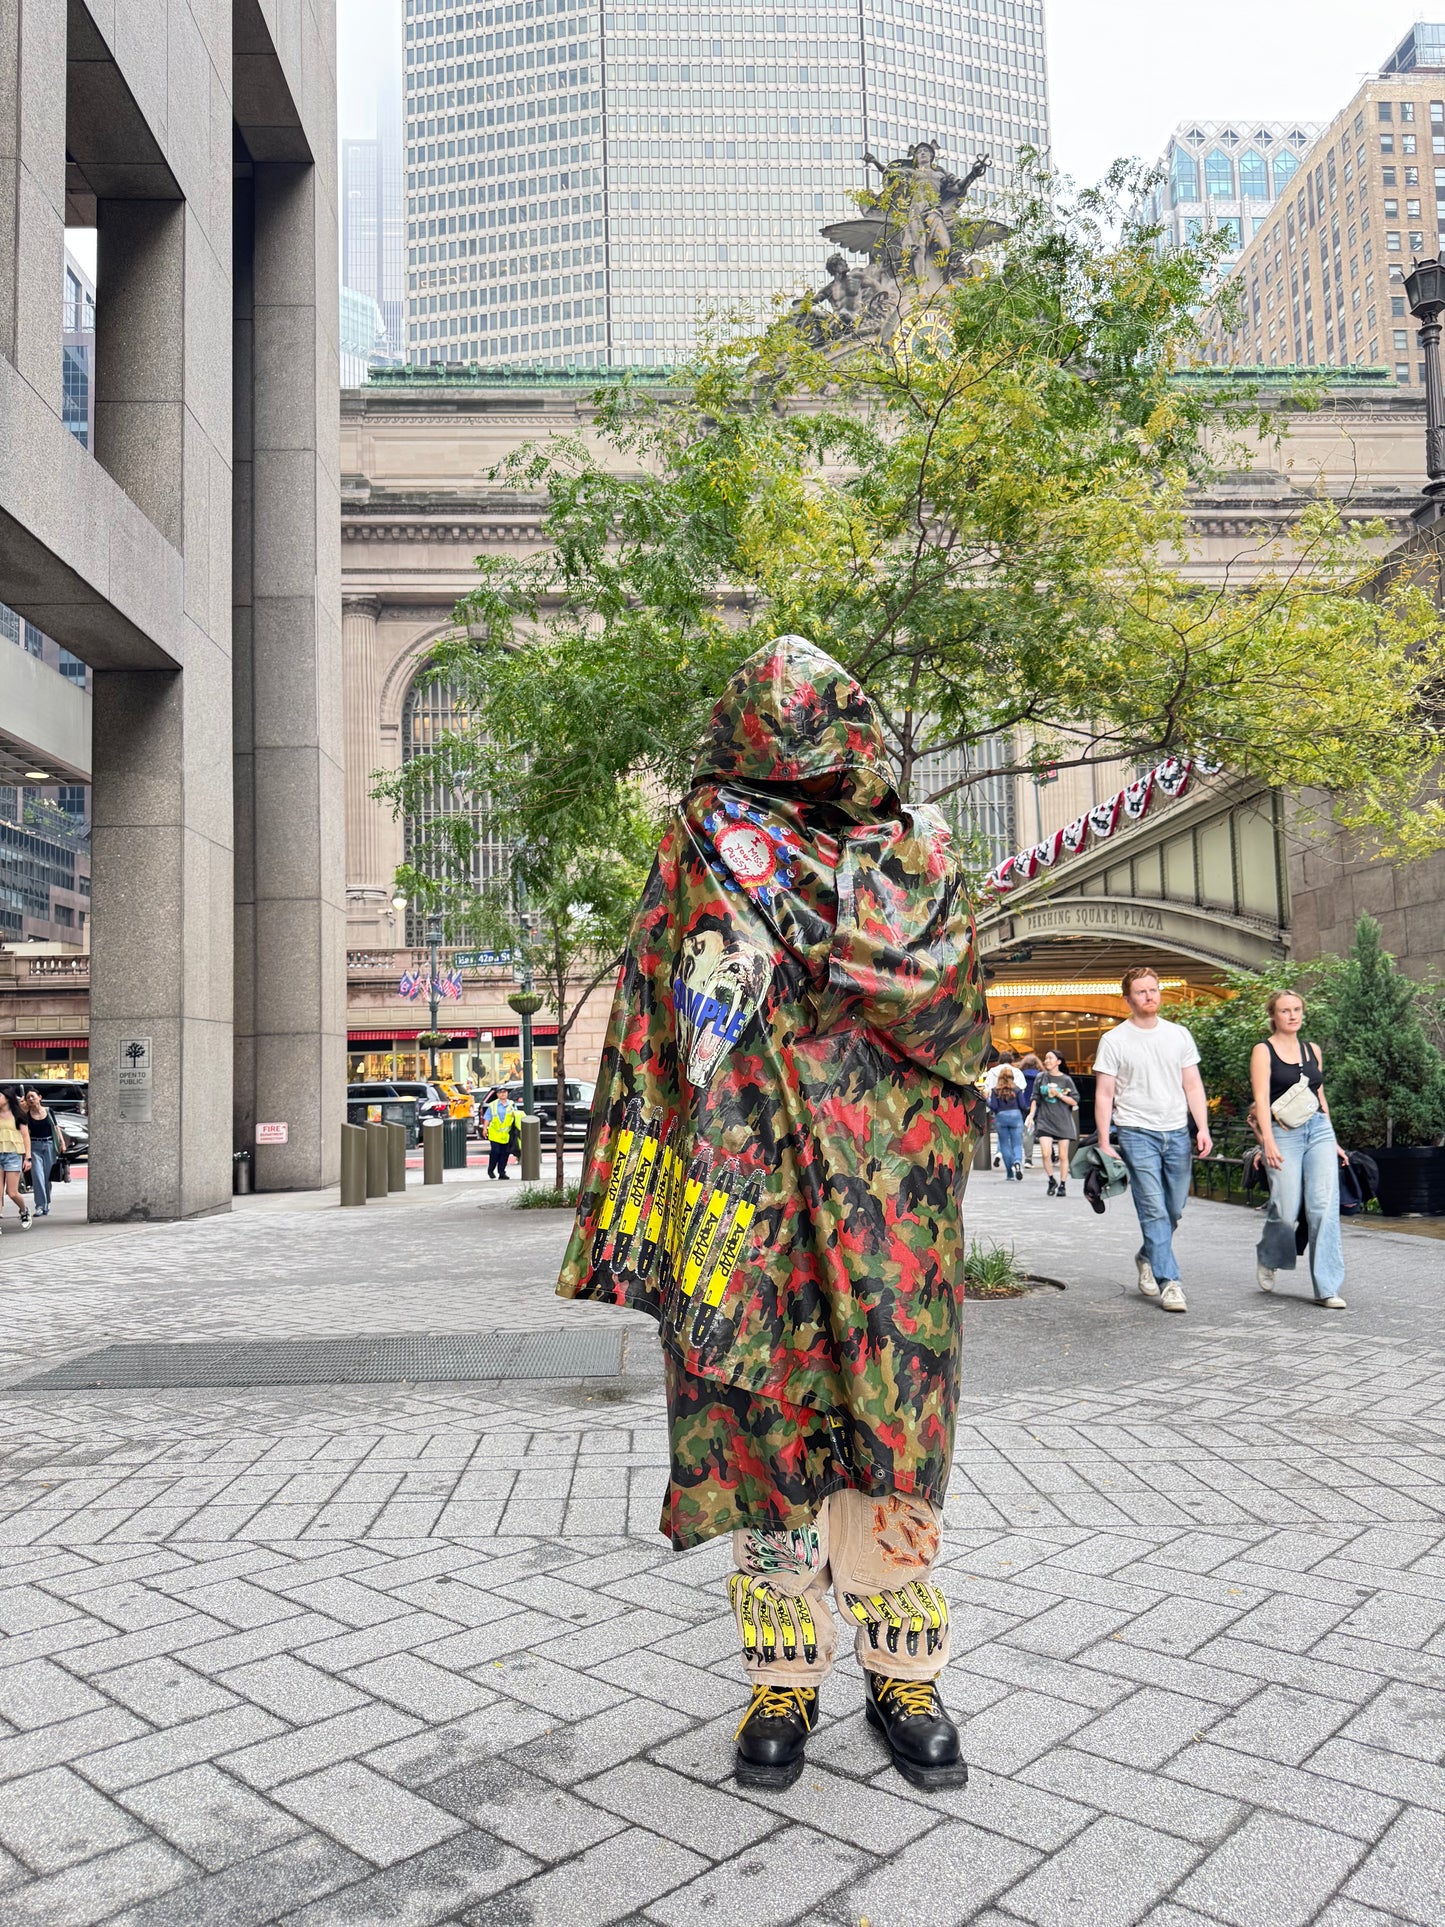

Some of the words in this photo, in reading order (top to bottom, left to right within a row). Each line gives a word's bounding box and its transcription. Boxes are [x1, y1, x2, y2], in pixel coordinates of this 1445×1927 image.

[1027, 909, 1071, 930] PERSHING
[1075, 908, 1117, 926] SQUARE
[1124, 910, 1164, 931] PLAZA
[673, 977, 746, 1044] SAMPLE
[262, 1125, 281, 1133] FIRE
